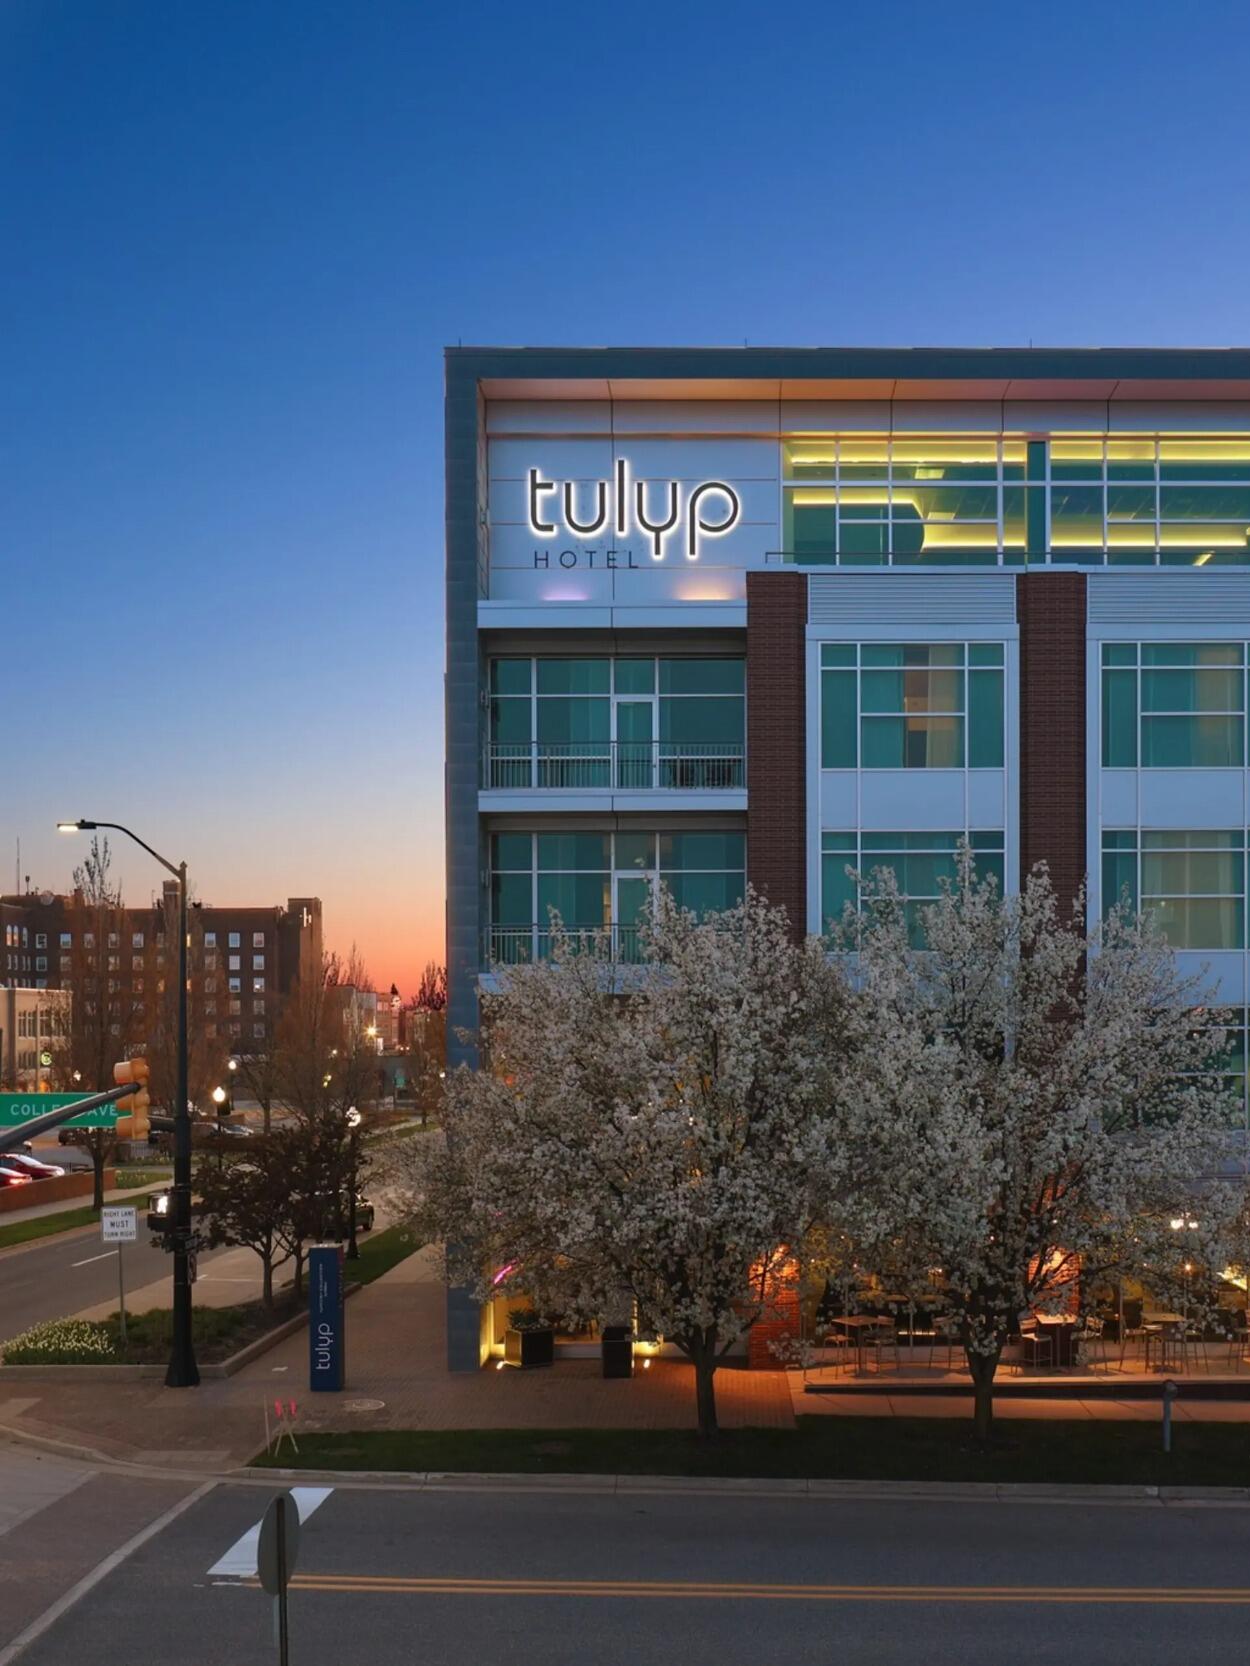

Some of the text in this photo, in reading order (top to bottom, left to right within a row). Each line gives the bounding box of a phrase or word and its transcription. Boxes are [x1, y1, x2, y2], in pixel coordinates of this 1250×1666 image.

[529, 458, 740, 557] tulyp
[534, 551, 639, 569] HOTEL
[10, 1103, 62, 1116] COLL
[110, 1220, 129, 1228] MUST
[315, 1322, 334, 1370] tulyp
